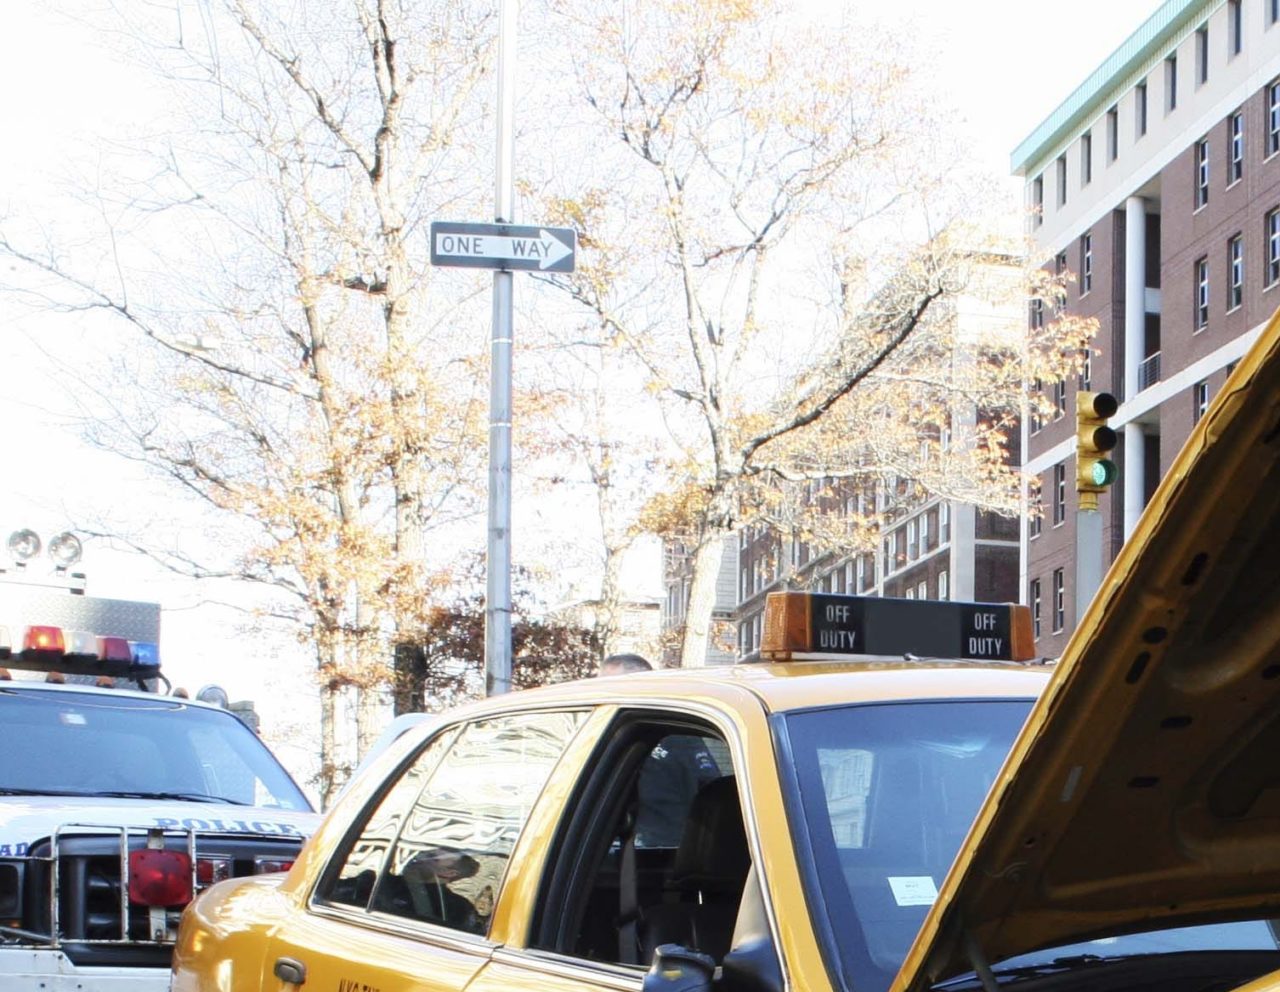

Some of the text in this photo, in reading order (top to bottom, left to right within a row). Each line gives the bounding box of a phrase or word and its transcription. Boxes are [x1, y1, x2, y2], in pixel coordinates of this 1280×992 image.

[442, 236, 553, 257] ONE WAY
[826, 604, 851, 623] OFF
[974, 612, 997, 631] OFF
[820, 630, 856, 650] DUTY
[969, 637, 1002, 656] DUTY
[152, 817, 302, 835] POLICE
